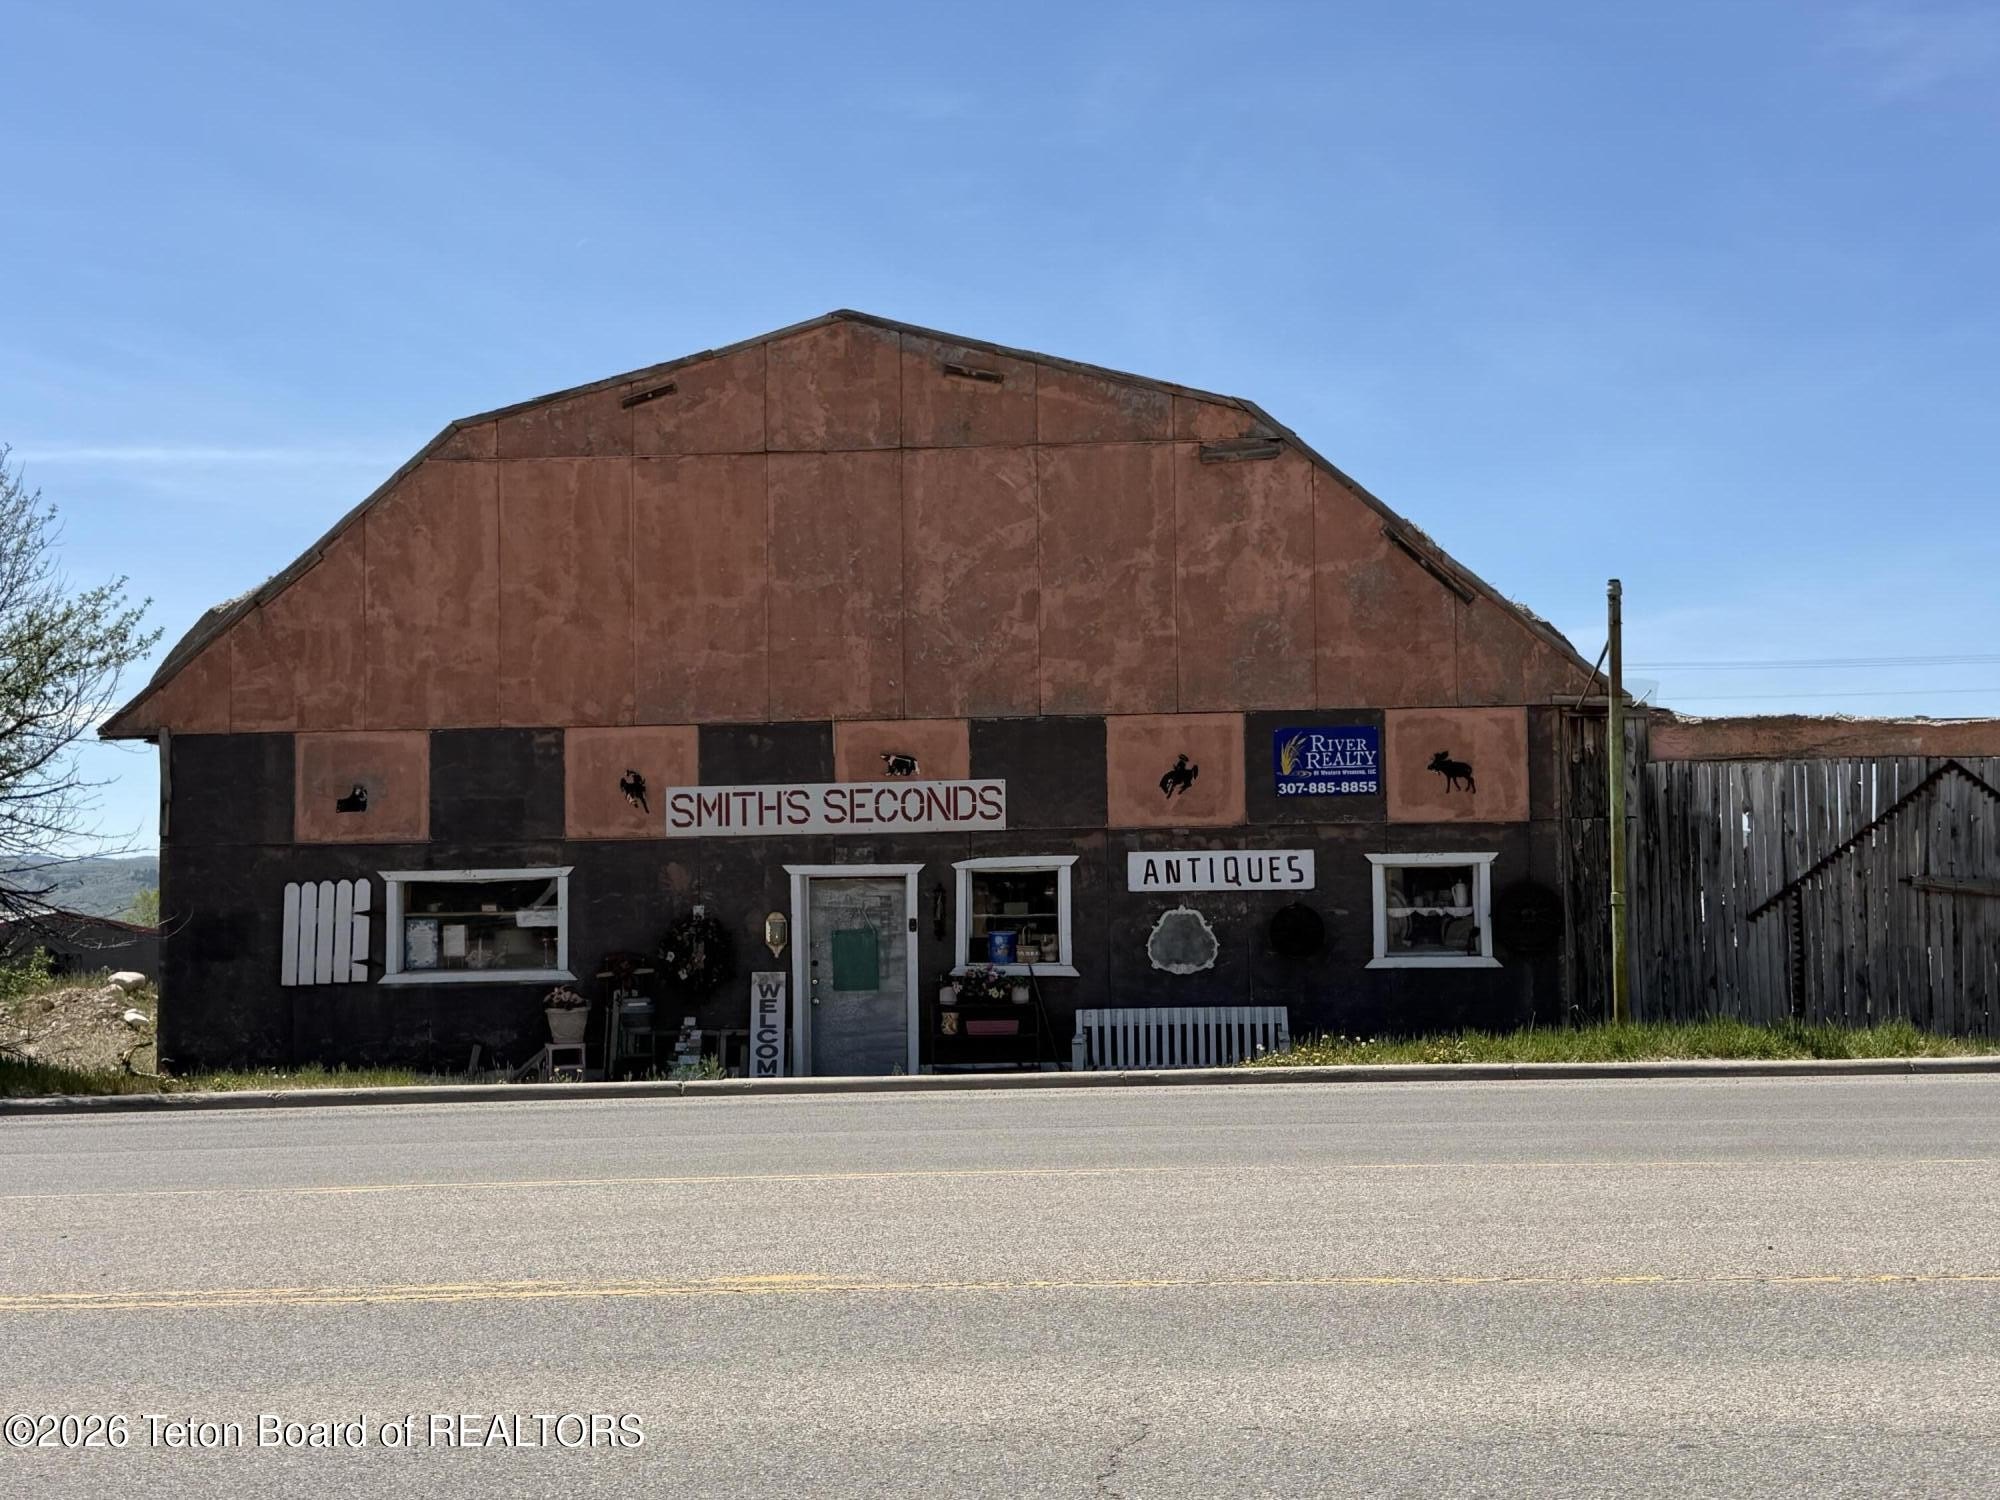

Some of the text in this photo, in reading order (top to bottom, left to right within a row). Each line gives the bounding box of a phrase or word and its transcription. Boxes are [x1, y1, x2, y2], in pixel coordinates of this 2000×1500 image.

[1310, 735, 1367, 752] RIVER
[1306, 751, 1376, 769] REALTY
[1278, 781, 1377, 794] 307-885-8855
[823, 785, 1003, 823] SECONDS
[1143, 855, 1304, 886] ANTIQUES
[756, 983, 781, 1078] WELCOM
